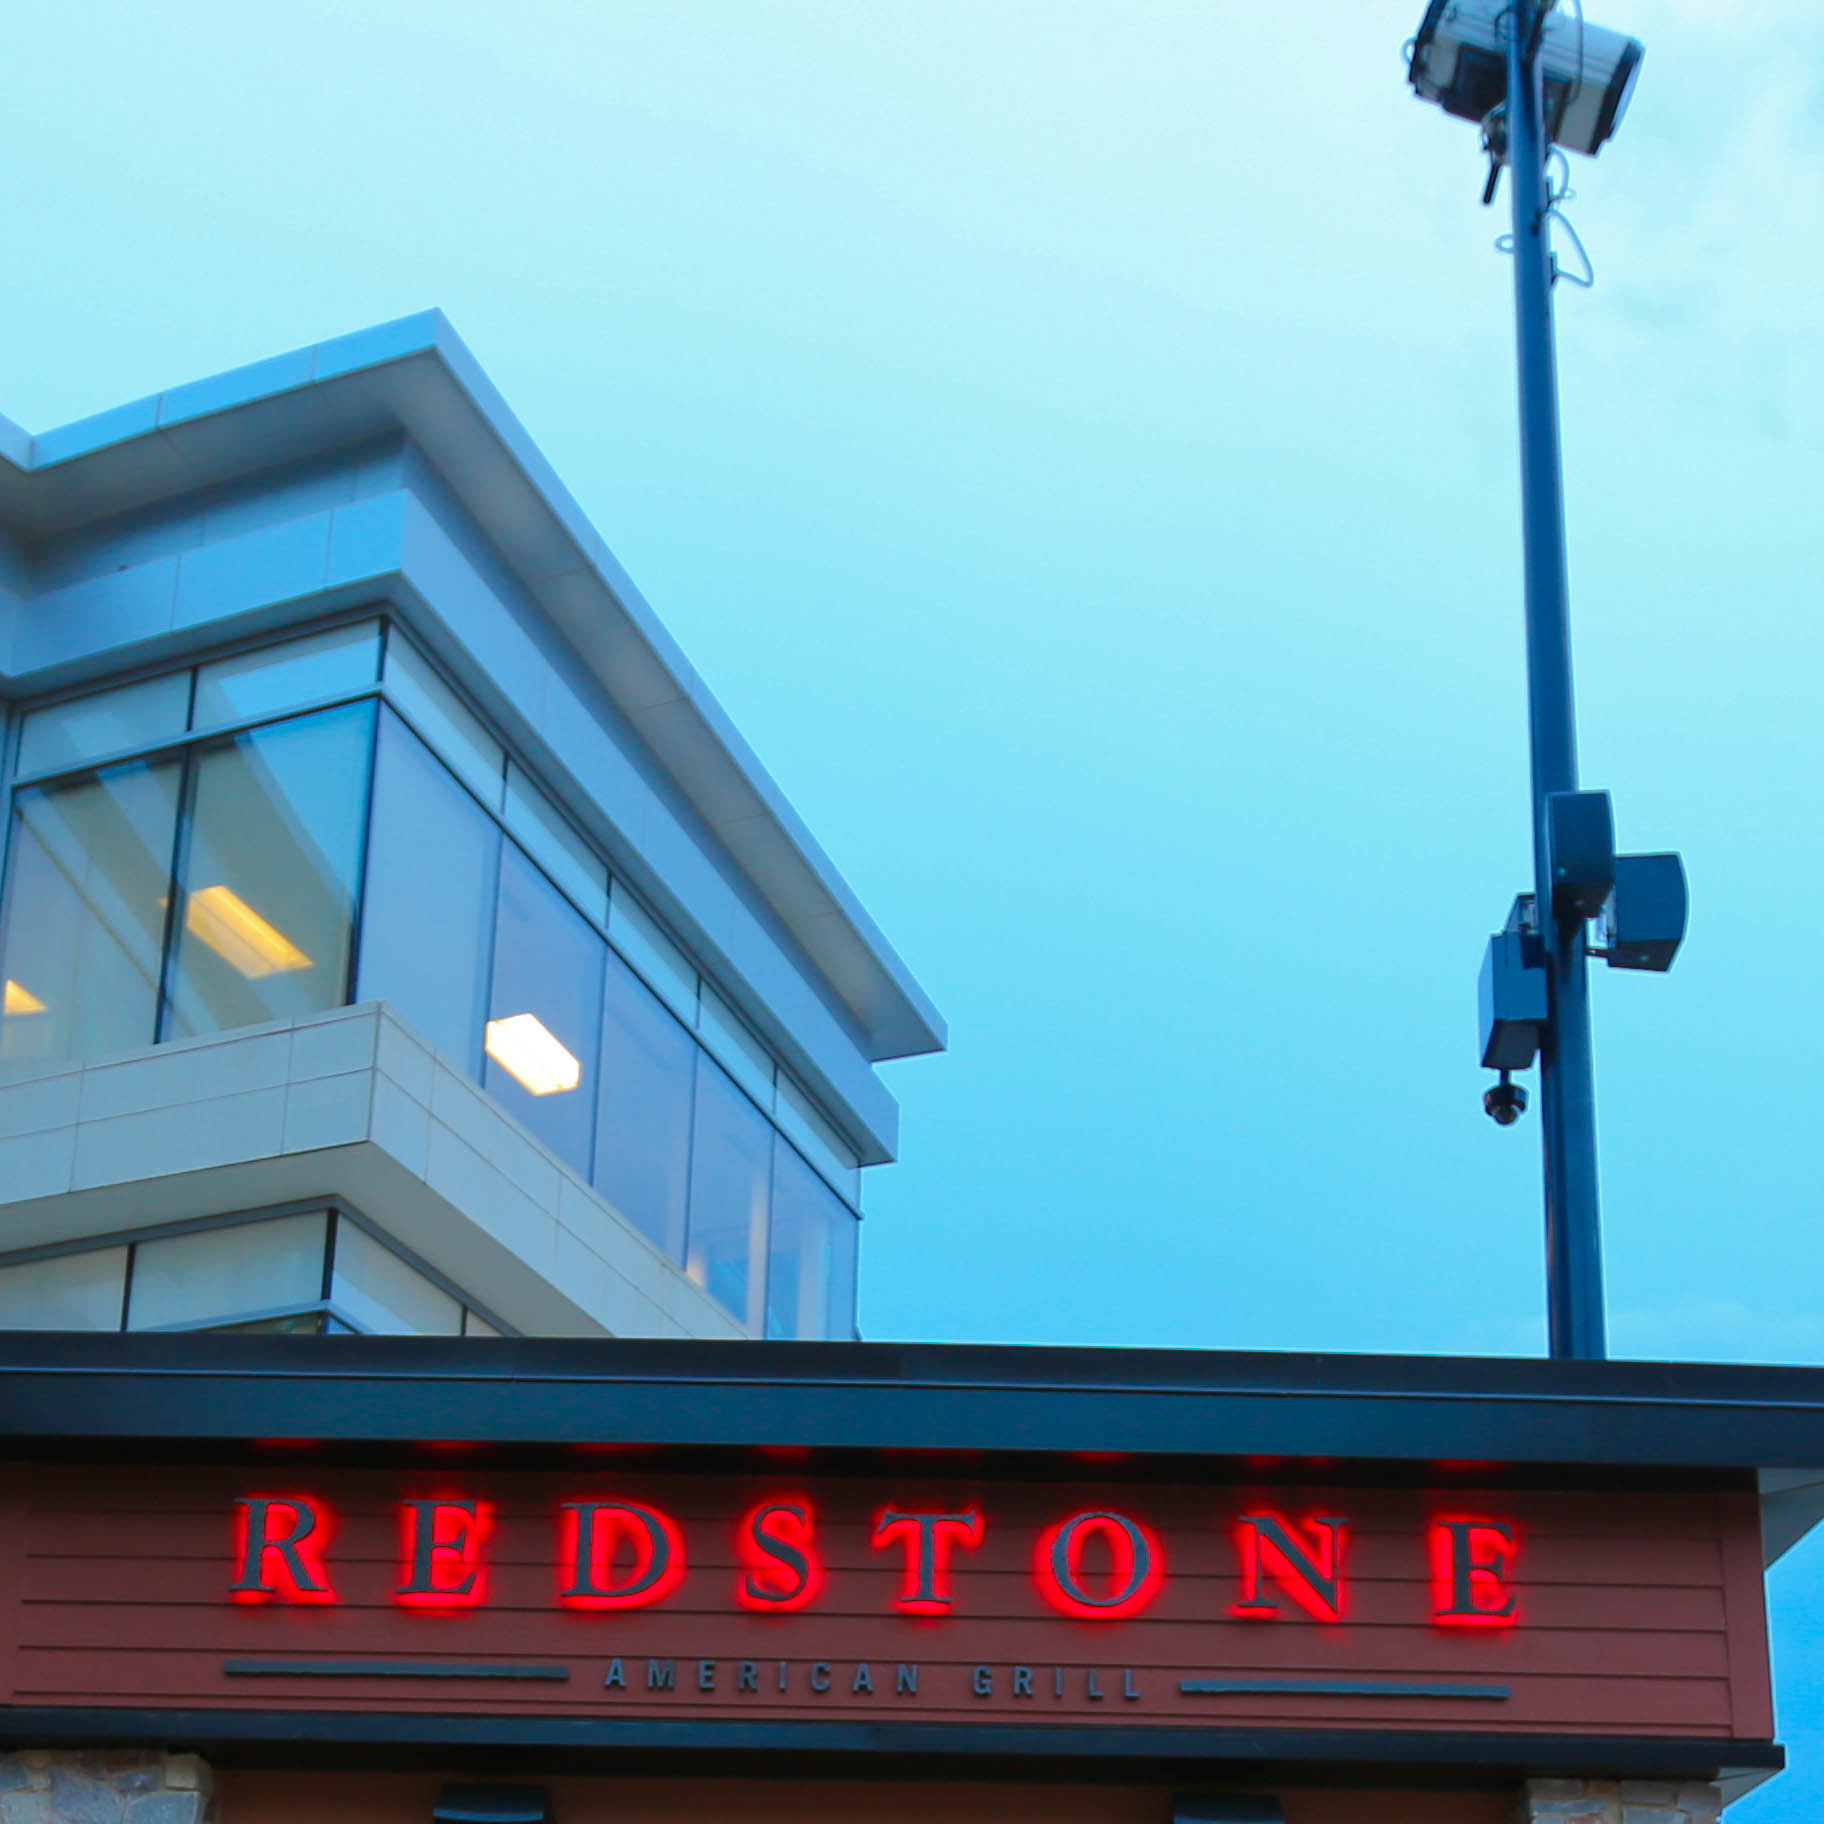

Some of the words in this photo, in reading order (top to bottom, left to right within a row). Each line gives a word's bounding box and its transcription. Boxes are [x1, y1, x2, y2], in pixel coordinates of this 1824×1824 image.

[228, 1497, 1518, 1618] REDSTONE
[603, 1656, 920, 1694] AMERICAN
[972, 1664, 1142, 1700] GRILL
